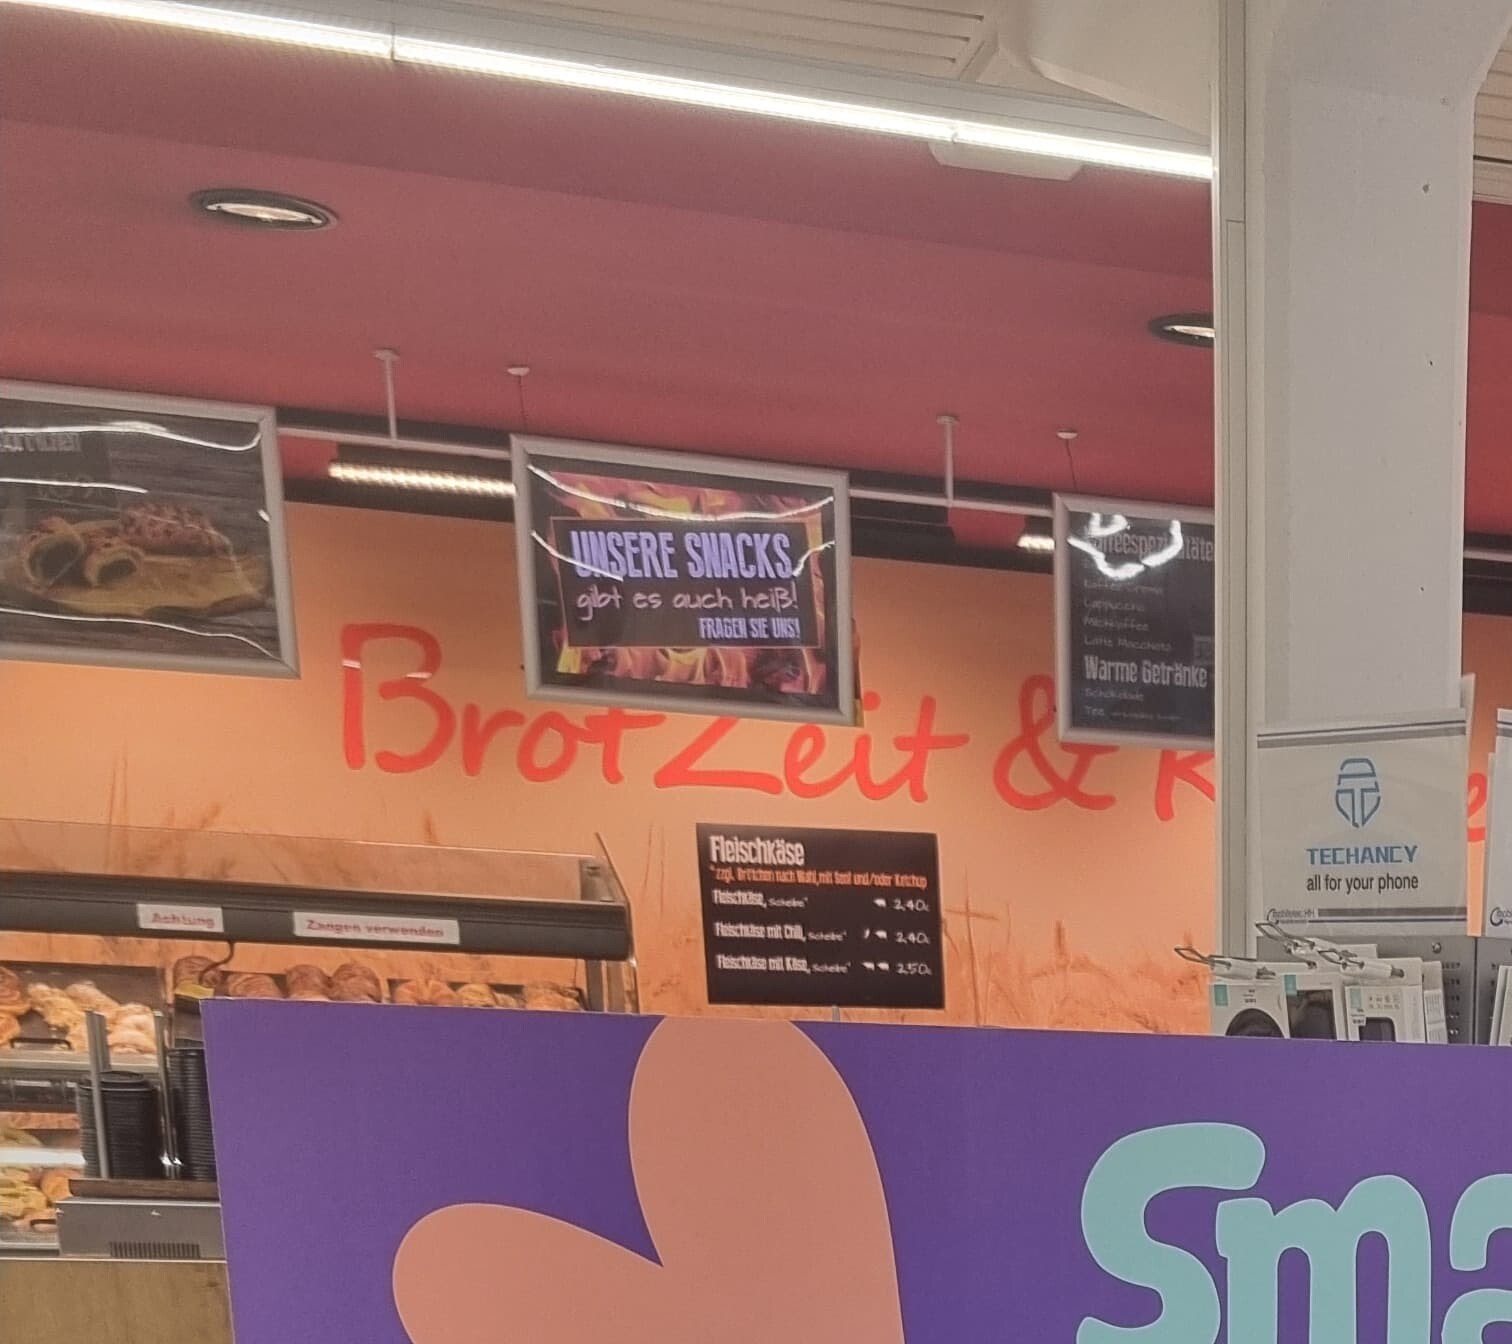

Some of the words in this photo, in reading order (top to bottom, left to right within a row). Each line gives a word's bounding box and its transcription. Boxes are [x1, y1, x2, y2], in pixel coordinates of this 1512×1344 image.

[570, 530, 678, 579] UNSERE
[683, 532, 793, 579] SNACKS
[577, 584, 623, 621] gibt
[633, 590, 663, 609] es
[673, 587, 732, 609] auch
[741, 581, 799, 612] heiß!
[699, 617, 748, 639] FRAGEN
[751, 618, 769, 639] SIE
[772, 618, 800, 639] UNS!
[1084, 654, 1138, 683] Warme
[1141, 660, 1208, 689] Getränke
[709, 835, 806, 866] Fleischkäse
[1305, 845, 1419, 867] TECHANCY
[1306, 873, 1322, 892] all
[1324, 873, 1342, 892] for
[1346, 876, 1374, 896] your
[1377, 874, 1419, 895] phone
[151, 910, 217, 930] Achtung
[305, 918, 362, 935] Zangen
[366, 922, 445, 939] verwenden
[767, 924, 783, 939] mit
[768, 956, 784, 971] mit
